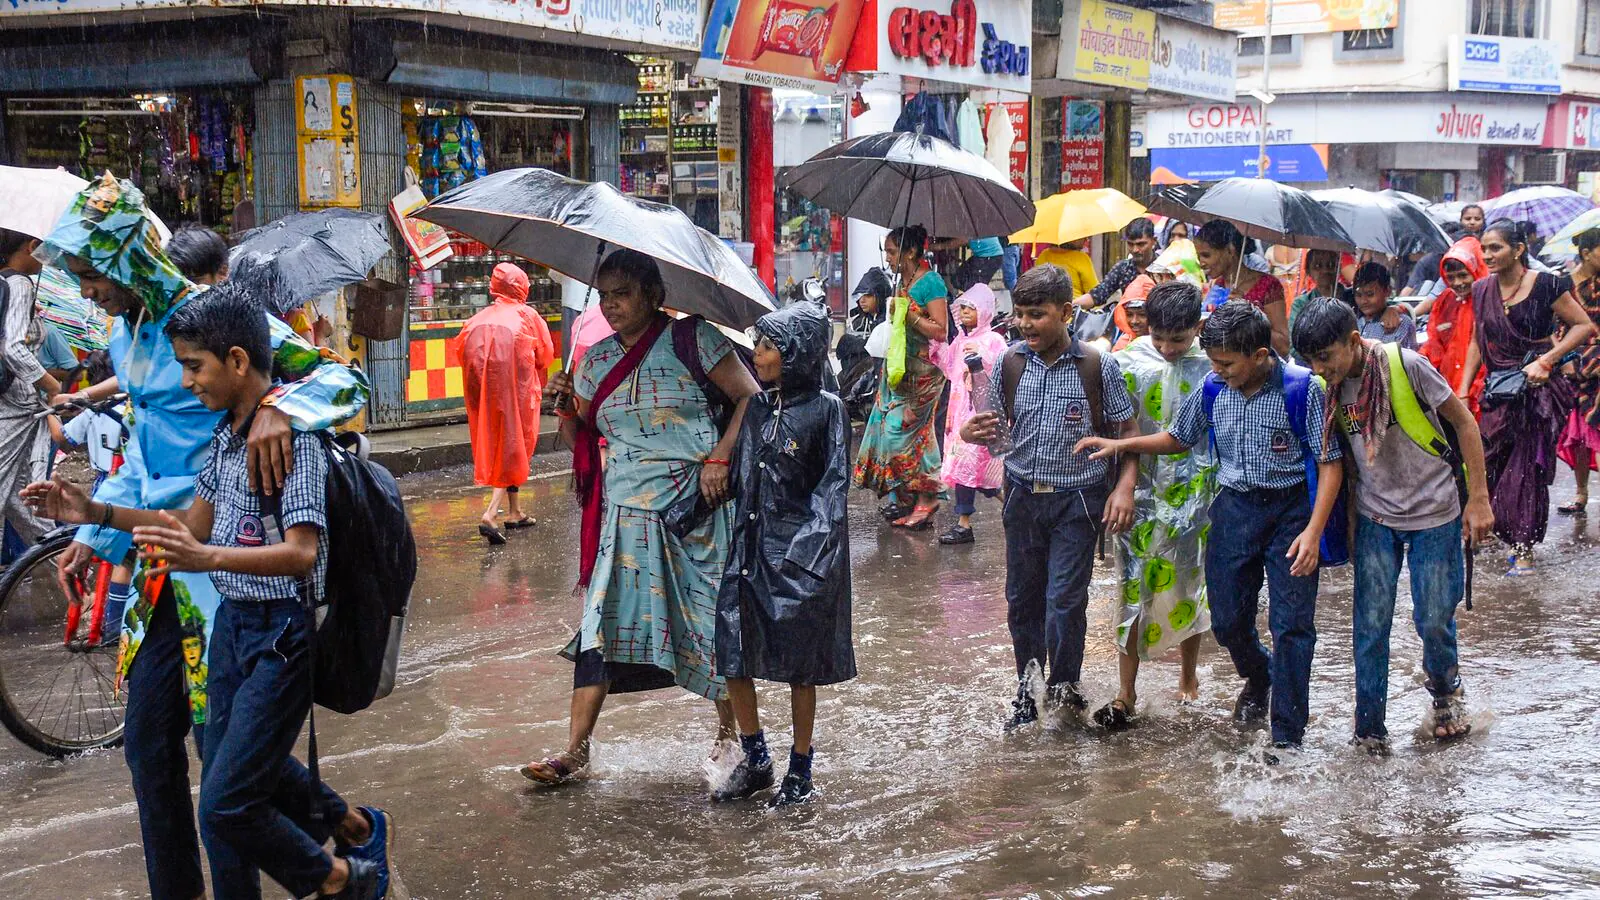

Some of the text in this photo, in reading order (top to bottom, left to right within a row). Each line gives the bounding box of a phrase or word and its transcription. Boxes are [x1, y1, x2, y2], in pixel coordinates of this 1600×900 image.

[744, 71, 772, 85] MATANGI
[772, 76, 801, 89] TOBACCO
[1437, 103, 1484, 138] ગોપાલ
[1168, 131, 1251, 146] STATIONERY
